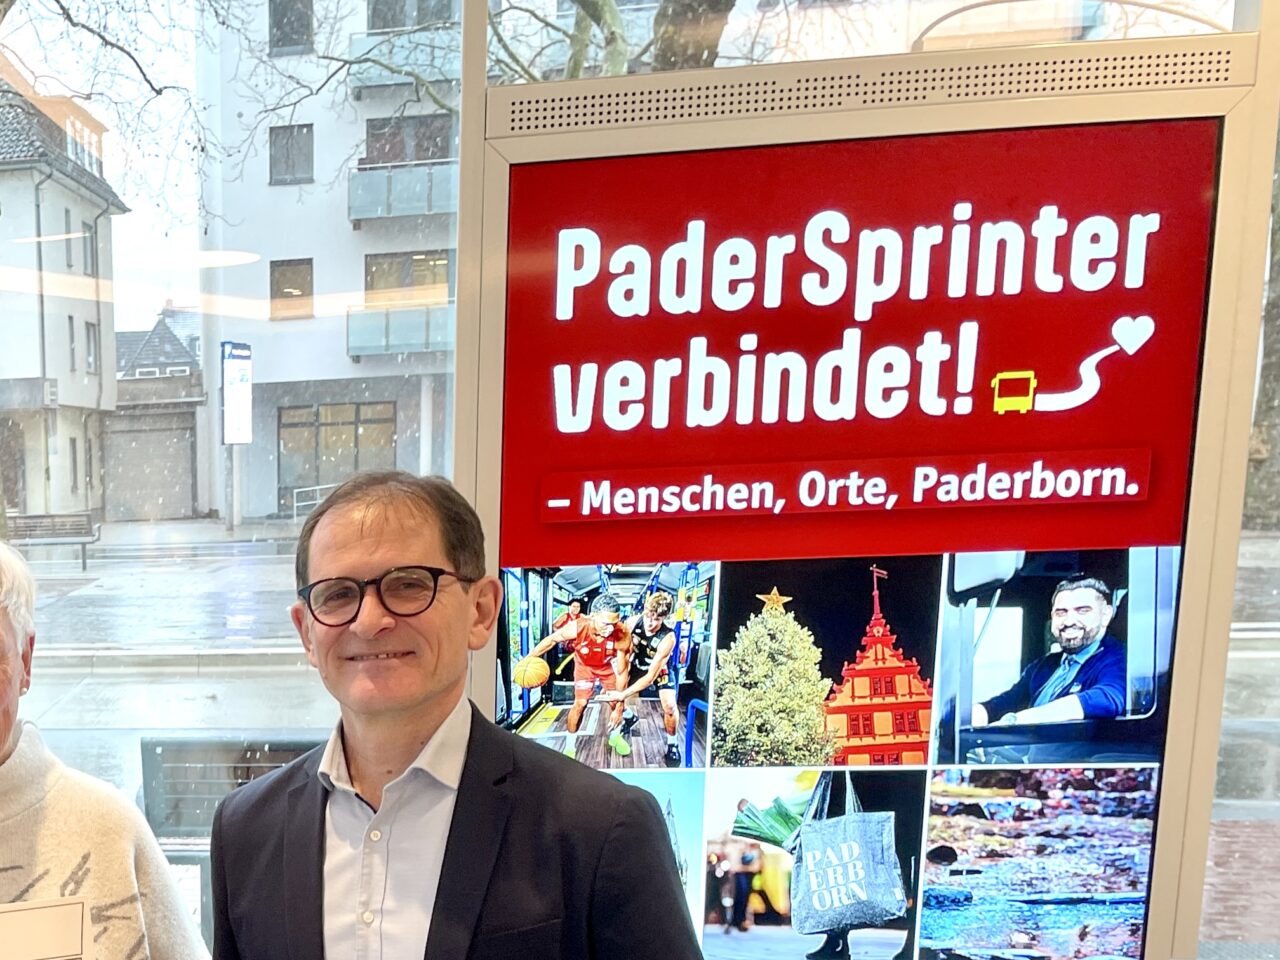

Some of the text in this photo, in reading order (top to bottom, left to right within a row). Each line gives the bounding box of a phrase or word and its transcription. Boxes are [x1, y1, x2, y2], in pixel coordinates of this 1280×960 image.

[554, 202, 1160, 321] PaderSprinter
[553, 321, 979, 434] verbindet!
[581, 474, 786, 516] Menschen,
[798, 471, 899, 511] Orte,
[913, 460, 1140, 503] Paderborn.
[805, 841, 860, 873] PAD
[809, 860, 866, 892] ERB
[812, 880, 869, 911] ORN
